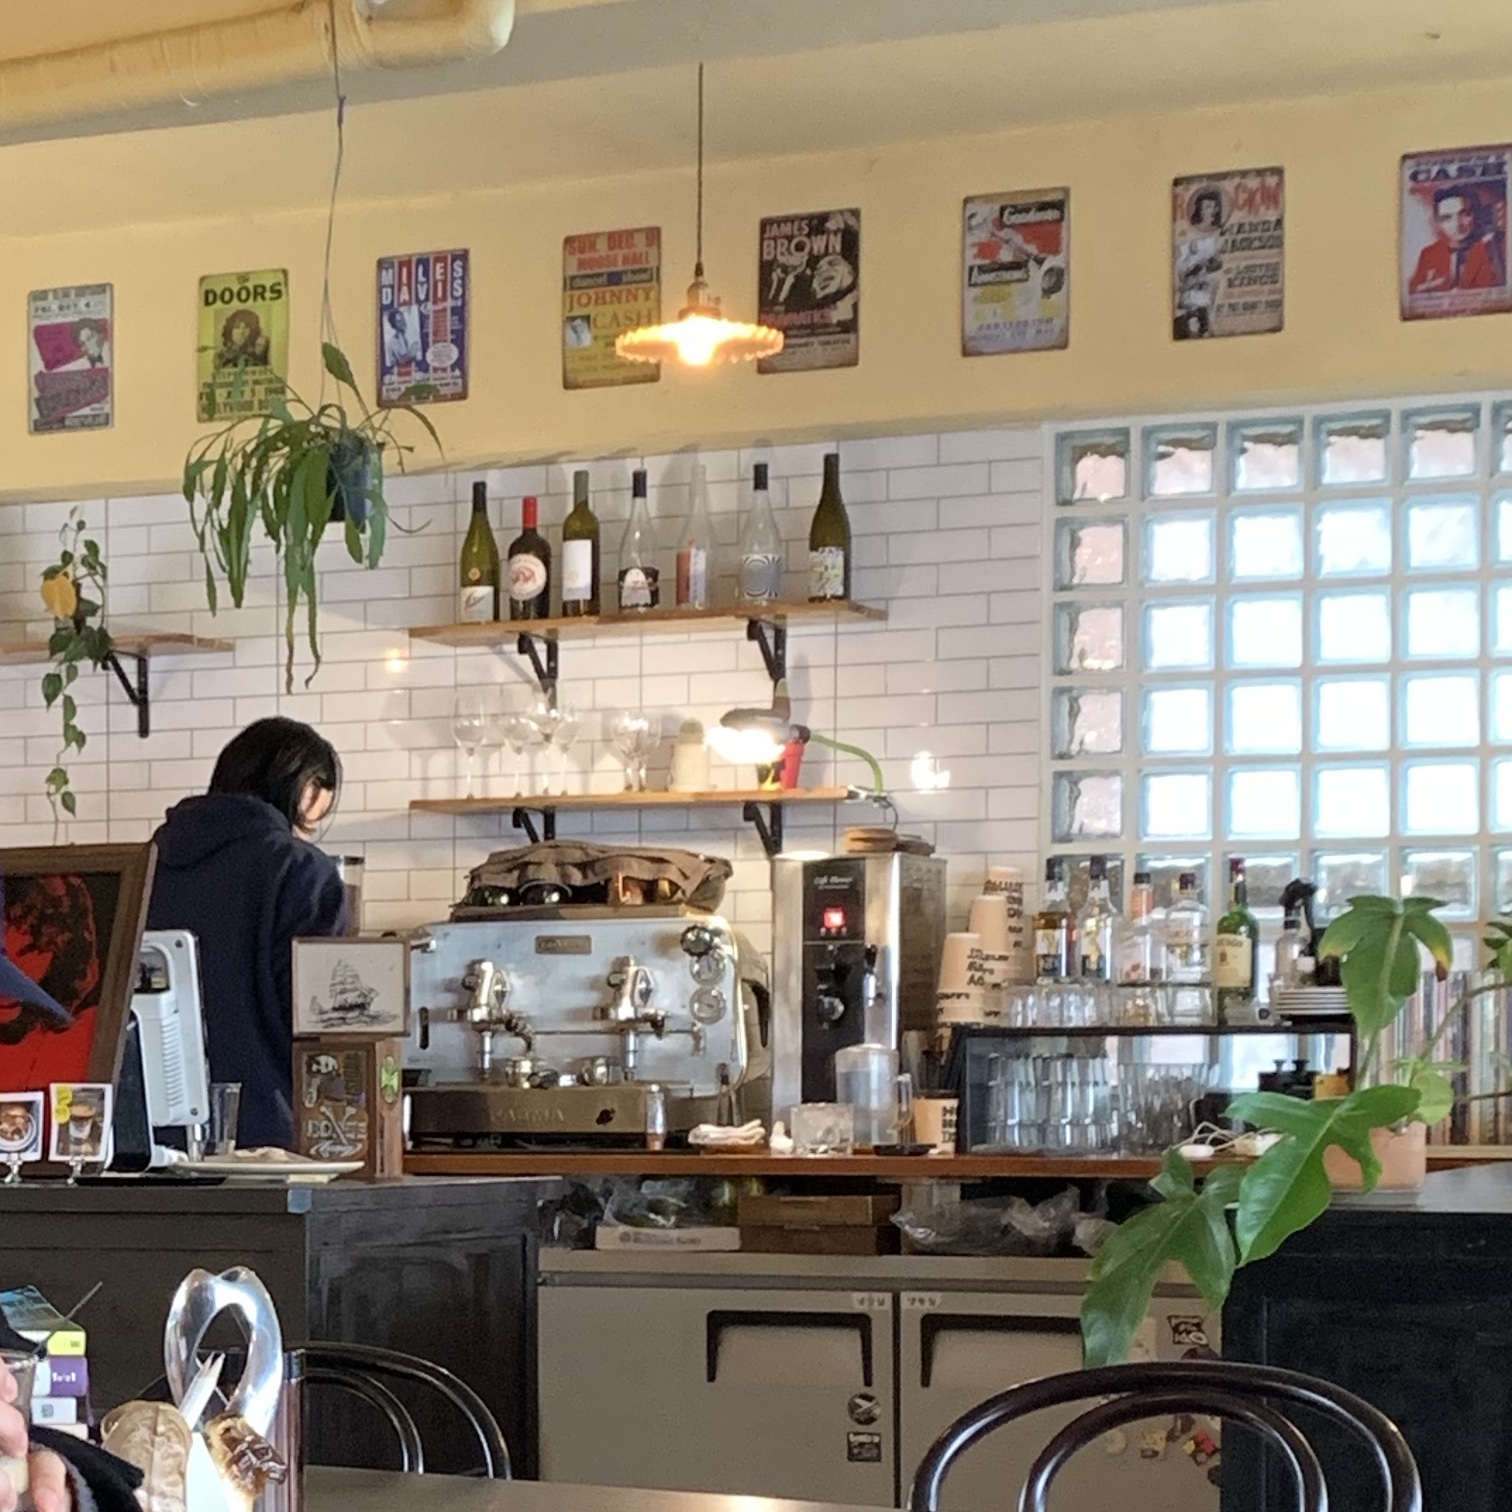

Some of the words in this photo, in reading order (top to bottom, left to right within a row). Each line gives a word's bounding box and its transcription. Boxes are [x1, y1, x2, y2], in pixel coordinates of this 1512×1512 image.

[763, 219, 809, 239] JAMES
[762, 231, 842, 261] BROWN
[204, 282, 283, 307] DOORS
[567, 287, 655, 313] JOHNNY
[592, 308, 653, 330] CASH
